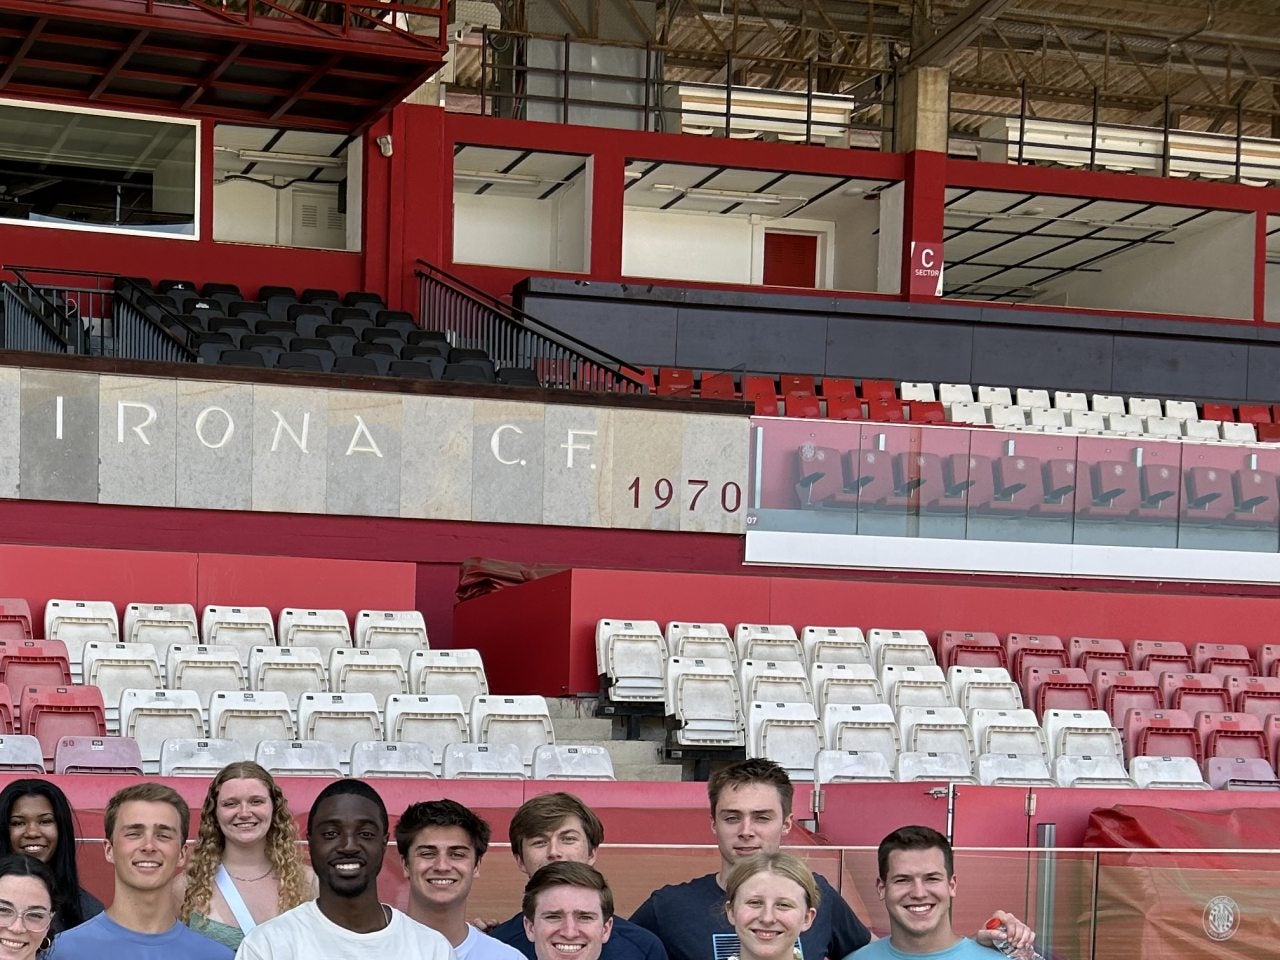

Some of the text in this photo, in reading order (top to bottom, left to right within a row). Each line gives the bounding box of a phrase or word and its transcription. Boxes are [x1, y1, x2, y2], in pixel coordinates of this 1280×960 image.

[921, 248, 934, 268] C
[915, 269, 940, 277] SECTOR
[628, 476, 743, 514] 1970
[747, 516, 757, 524] 07
